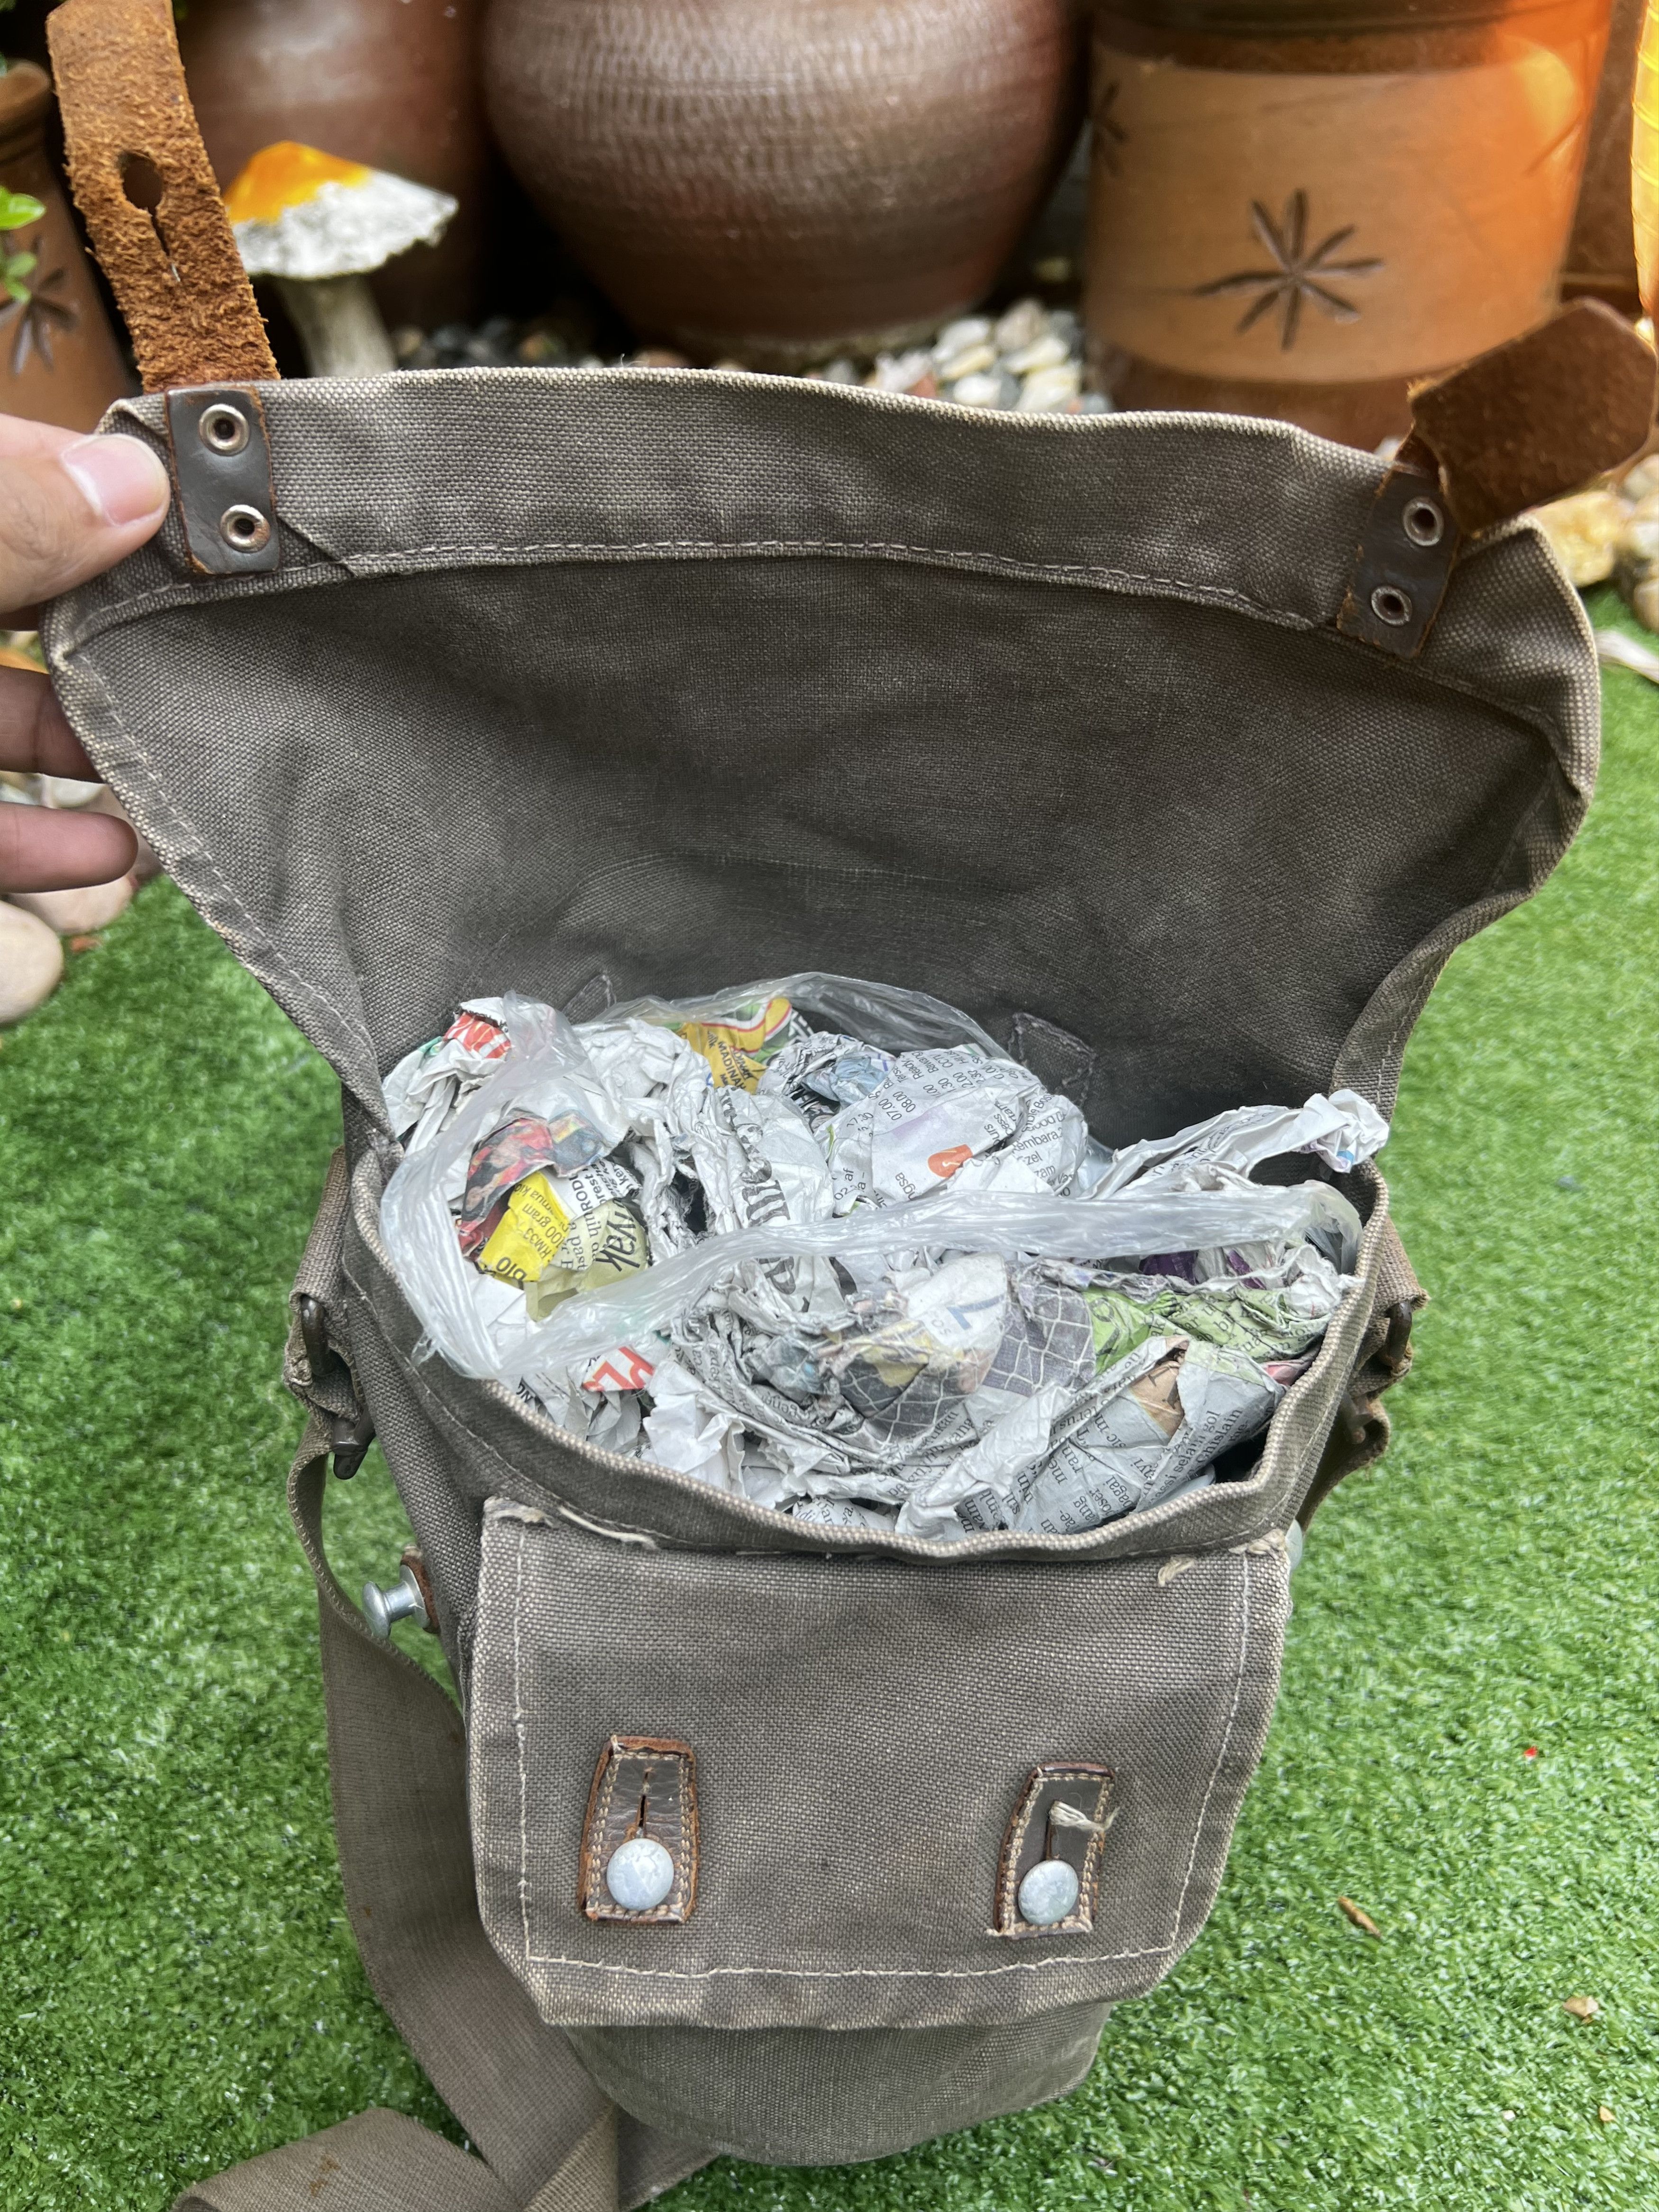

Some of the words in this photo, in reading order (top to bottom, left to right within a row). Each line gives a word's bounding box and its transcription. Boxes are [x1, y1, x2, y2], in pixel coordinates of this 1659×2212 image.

[912, 1050, 939, 1074] Bawang
[878, 1098, 902, 1121] 07.00
[892, 1091, 916, 1113] 08.00
[847, 1112, 874, 1128] 17.30
[521, 1202, 551, 1229] gram
[523, 1227, 551, 1259] RM33
[568, 1234, 588, 1272] past
[1203, 1410, 1221, 1433] gol
[1173, 1434, 1206, 1473] selain
